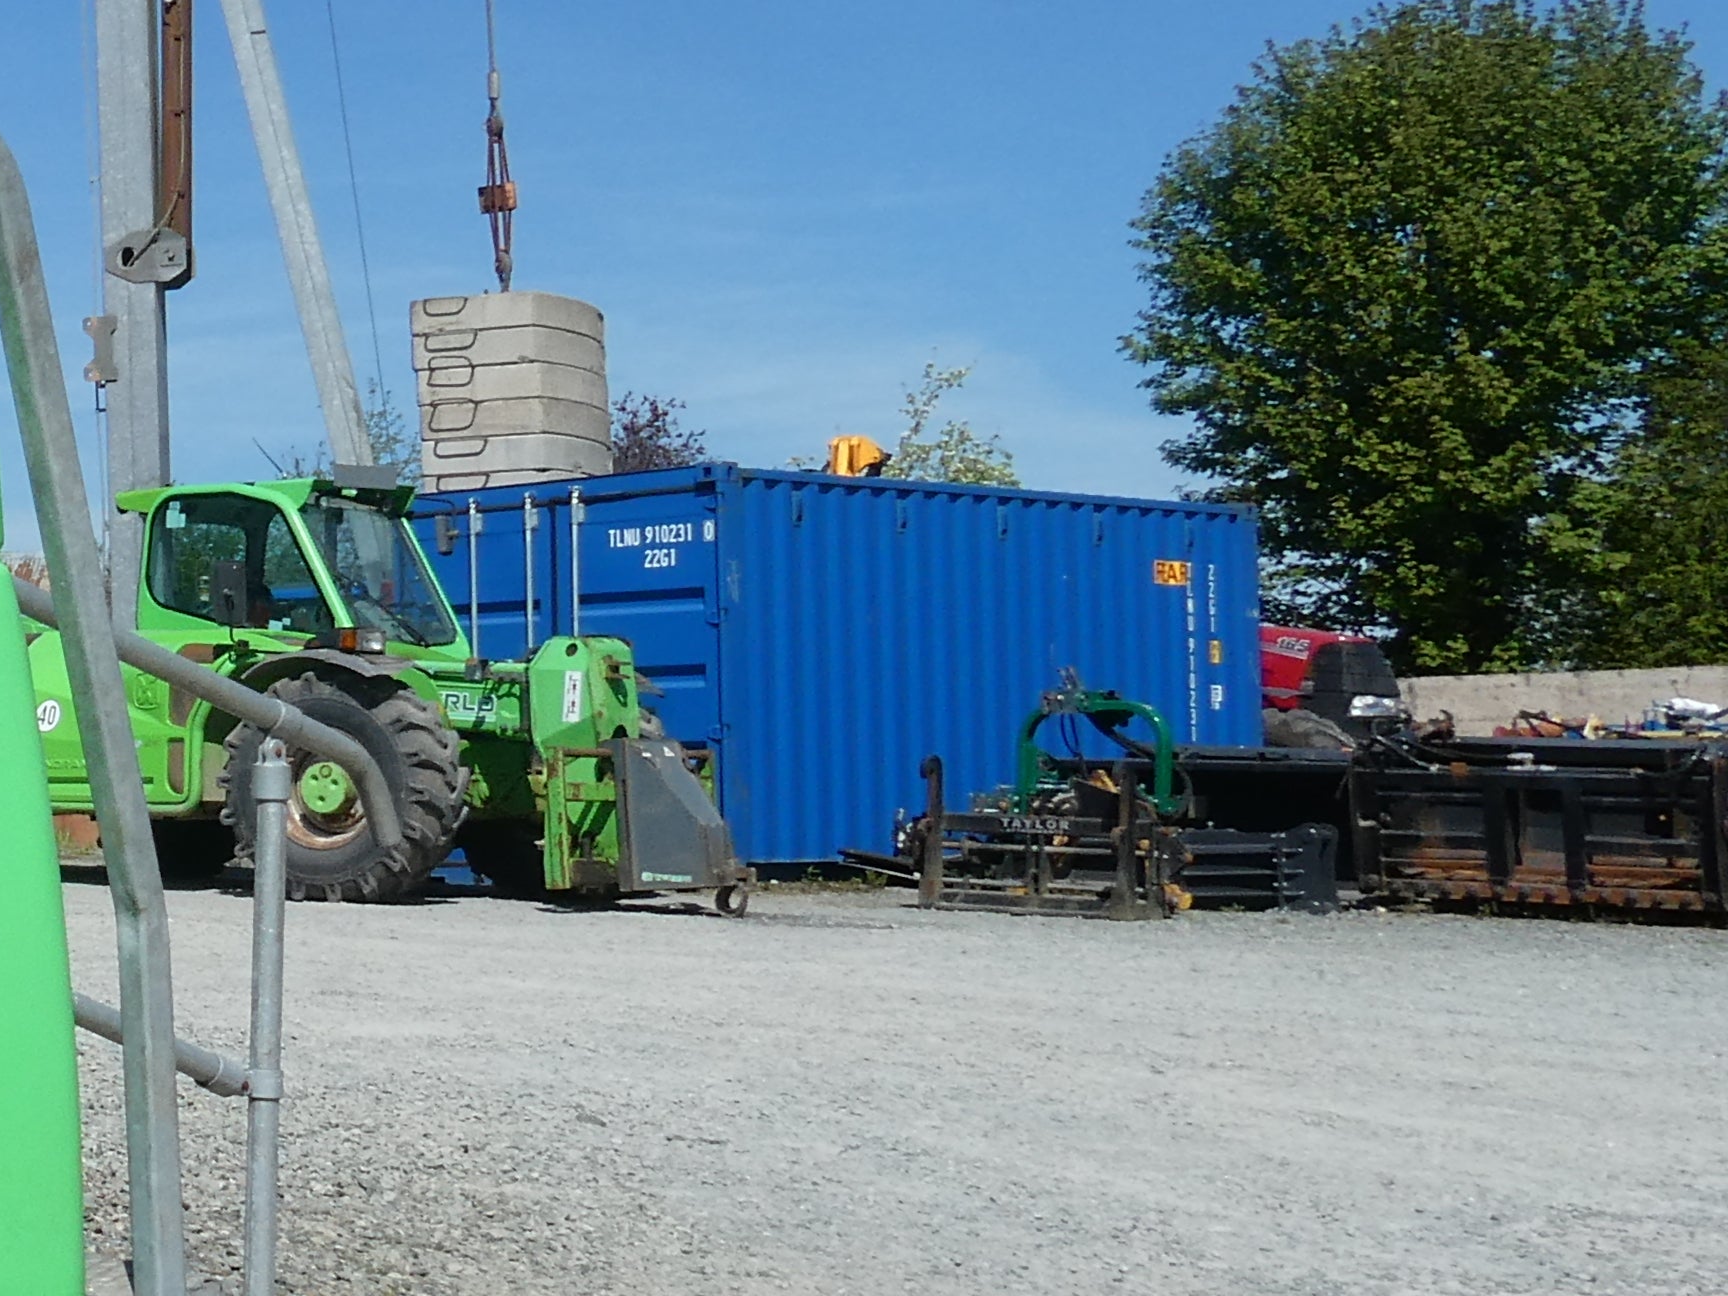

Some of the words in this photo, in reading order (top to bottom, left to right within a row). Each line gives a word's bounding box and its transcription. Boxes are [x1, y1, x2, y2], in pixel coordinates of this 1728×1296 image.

[608, 528, 641, 548] TLNU
[645, 523, 692, 543] 910231
[704, 521, 715, 540] 0
[644, 548, 676, 568] 22G1
[38, 705, 57, 726] 40
[1000, 817, 1070, 830] TAYLOR
